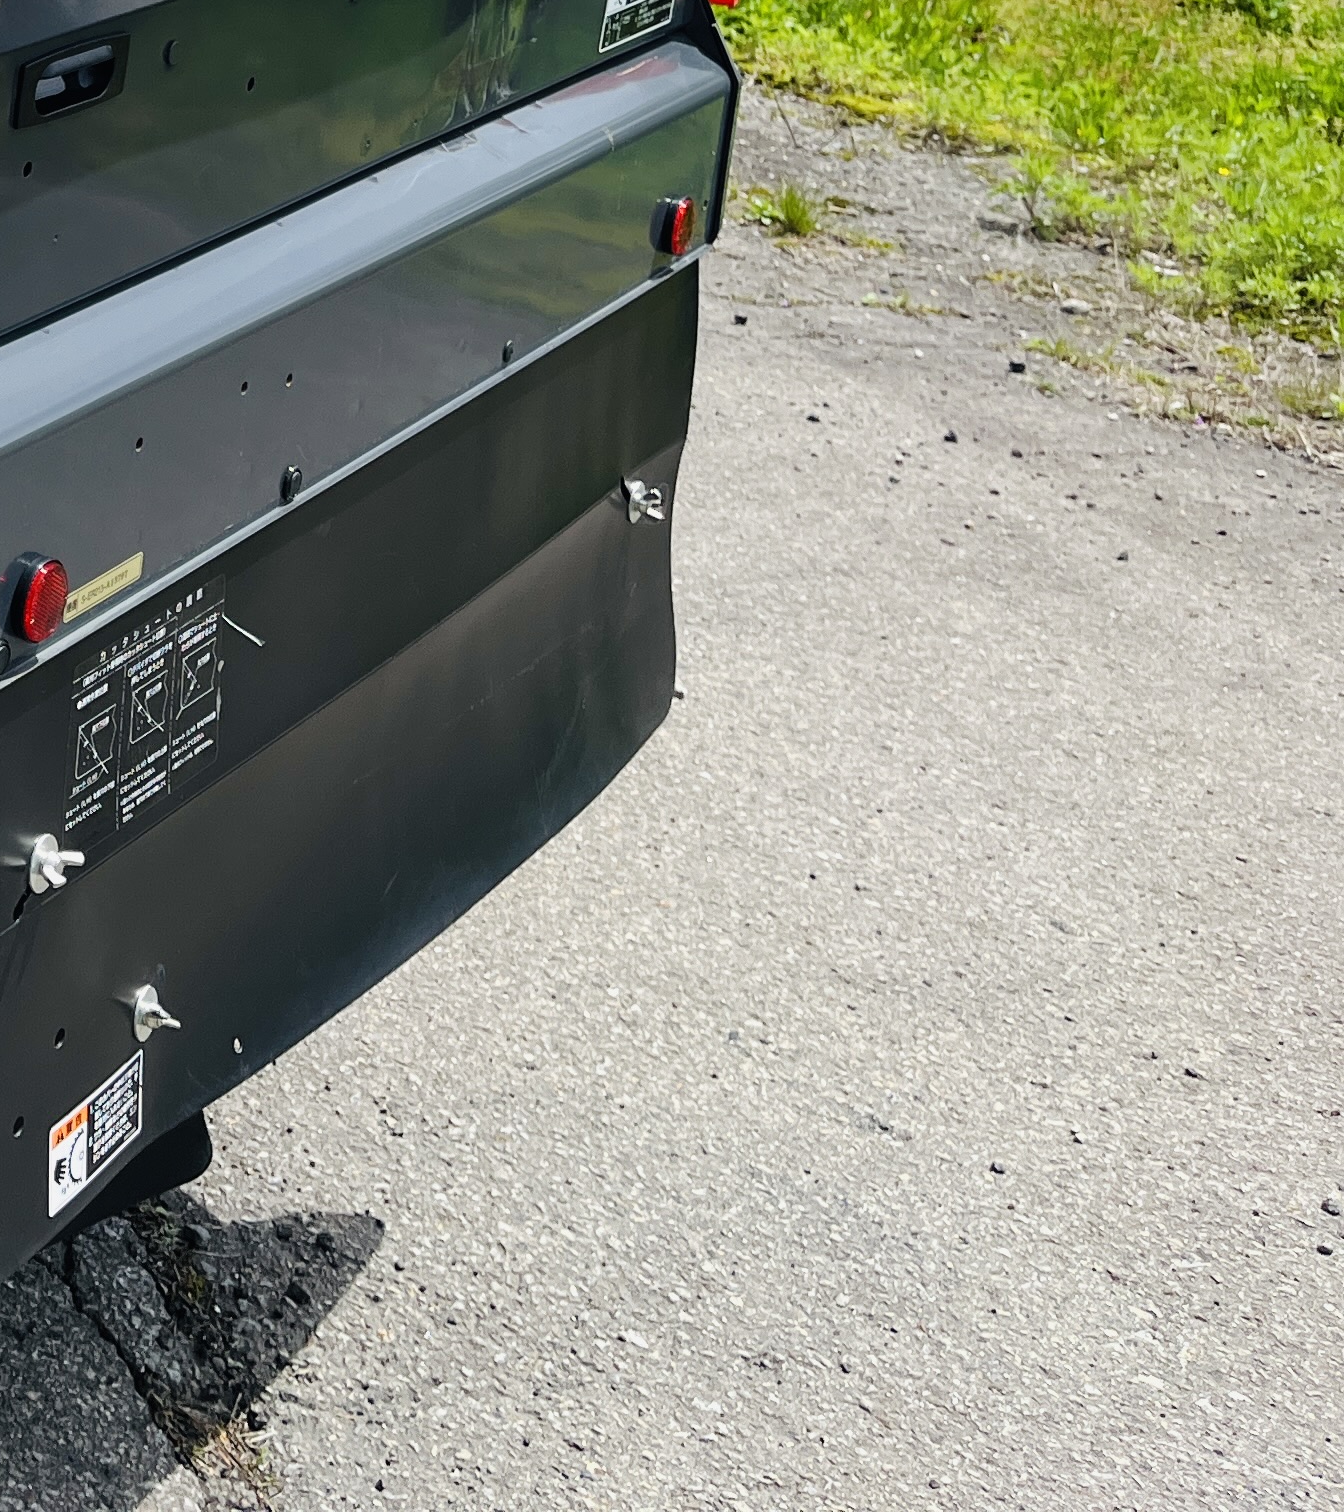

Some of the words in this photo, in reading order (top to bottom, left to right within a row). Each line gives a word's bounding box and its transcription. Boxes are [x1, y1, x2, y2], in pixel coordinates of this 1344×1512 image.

[99, 587, 204, 663] カッタシュートの
